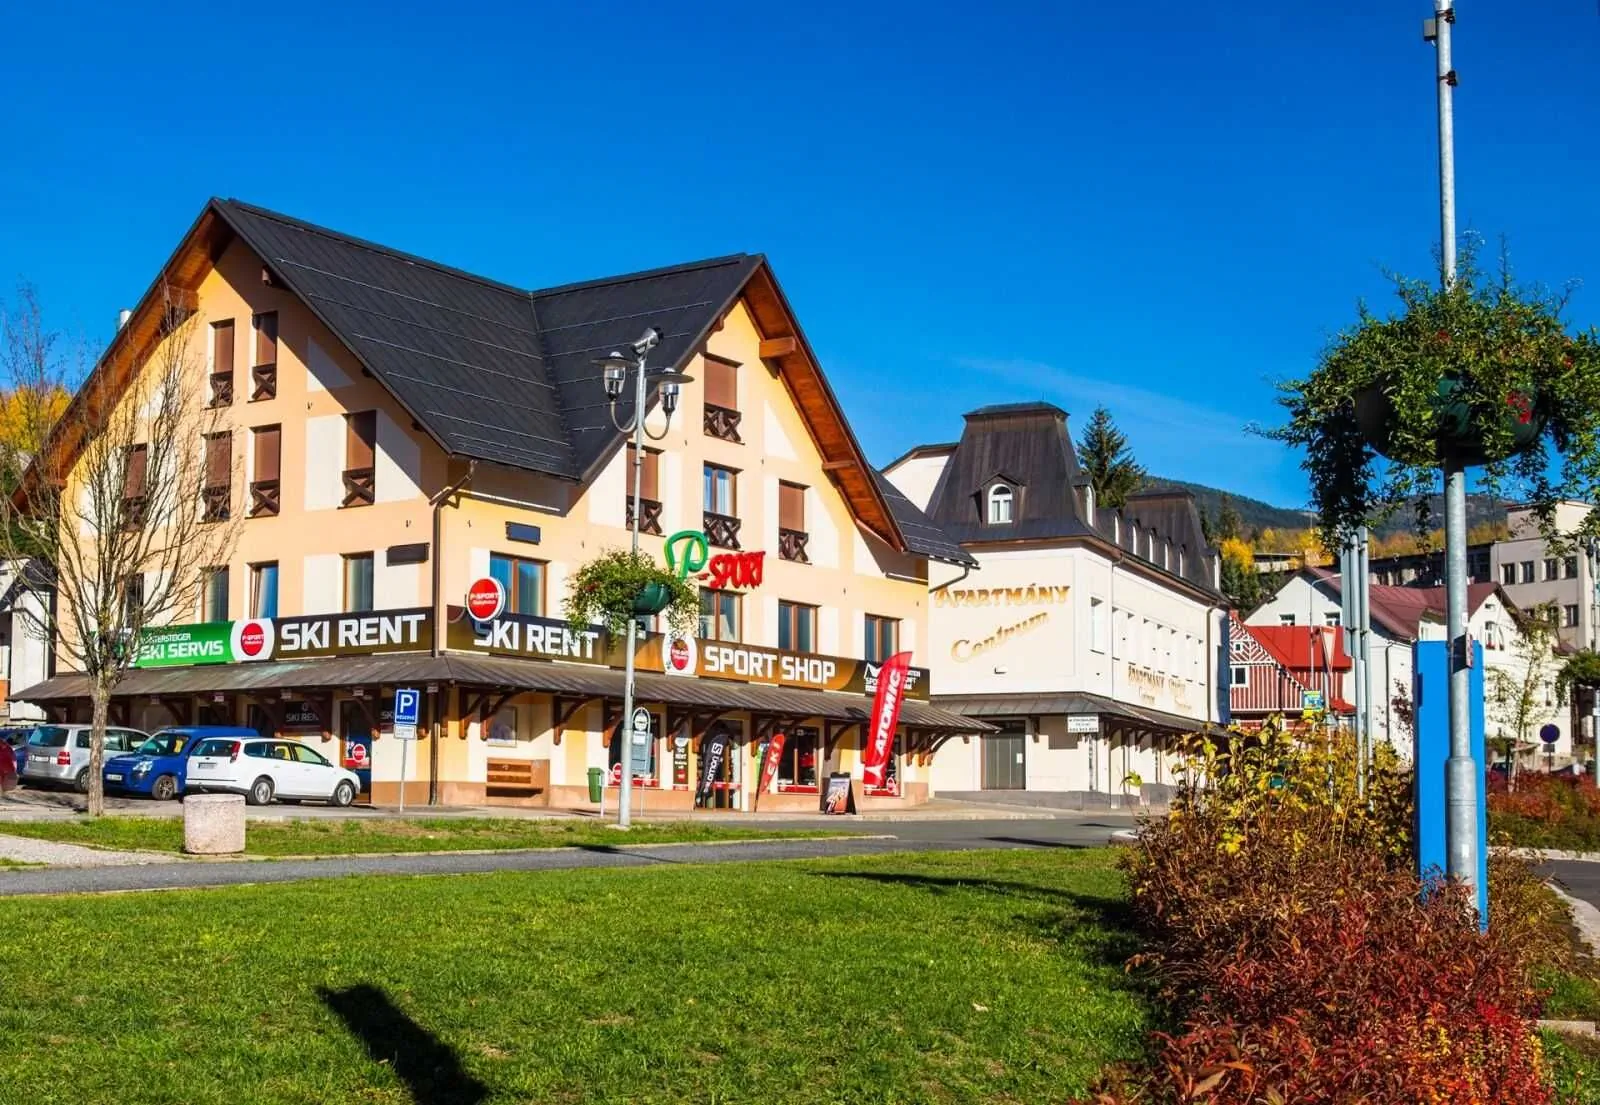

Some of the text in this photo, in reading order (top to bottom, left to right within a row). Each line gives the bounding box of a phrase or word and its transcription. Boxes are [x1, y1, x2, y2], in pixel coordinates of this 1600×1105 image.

[934, 583, 1070, 607] APARTMÁNY
[142, 633, 191, 645] TERSTEIGER
[280, 613, 426, 651] SKI RENT
[473, 619, 599, 659] SKI RENT
[140, 639, 224, 661] SKI SERVIS
[704, 646, 777, 679] SPORT
[781, 658, 836, 685] SHOP
[400, 694, 414, 714] P
[875, 669, 901, 757] ATOMIC
